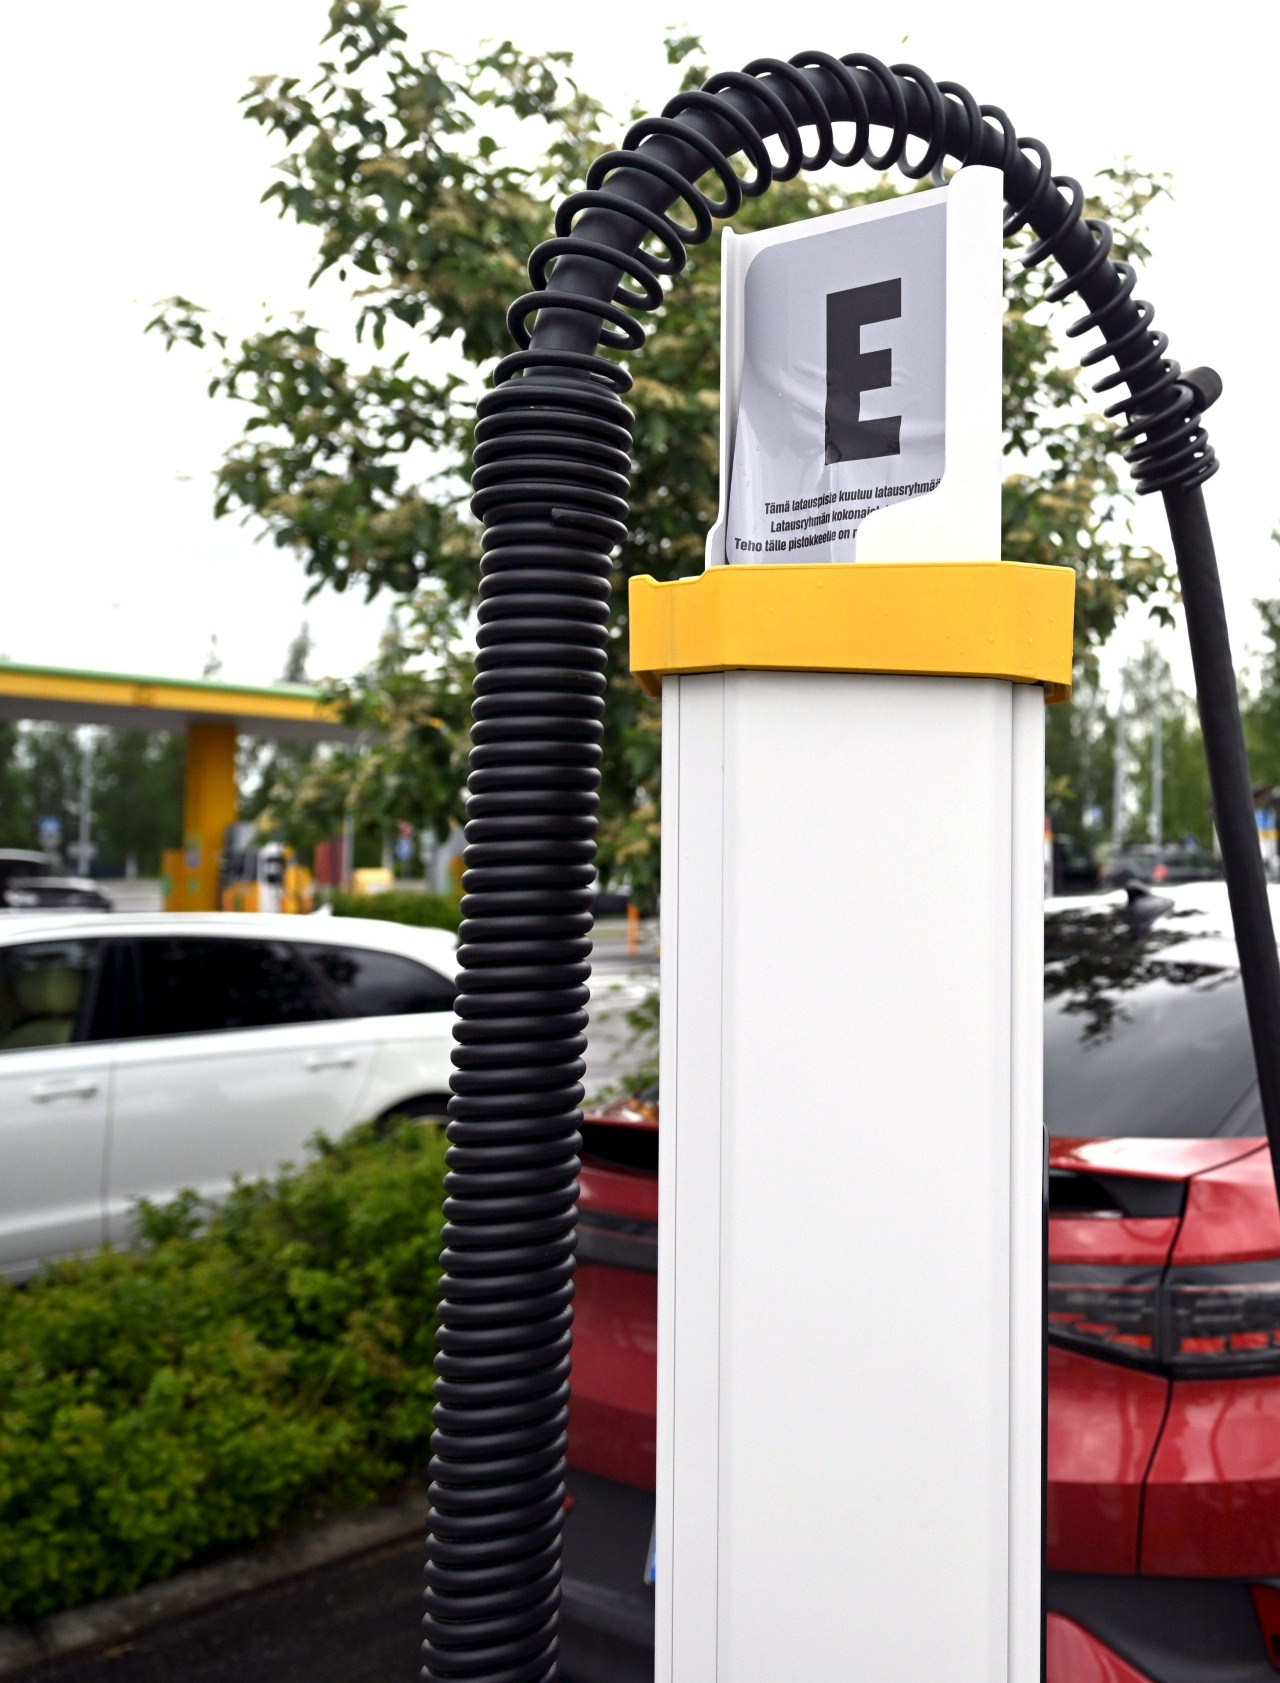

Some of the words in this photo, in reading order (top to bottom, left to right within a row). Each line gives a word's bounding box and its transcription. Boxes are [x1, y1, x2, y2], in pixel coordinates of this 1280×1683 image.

[825, 277, 902, 465] E
[764, 501, 790, 514] Tämä
[791, 492, 837, 511] latauspiste
[839, 488, 873, 502] kuuluu
[770, 512, 830, 533] Latausryhmän
[734, 537, 763, 552] Teho
[764, 540, 787, 552] tälle
[788, 530, 837, 551] pistokkeelle
[838, 529, 851, 540] on
